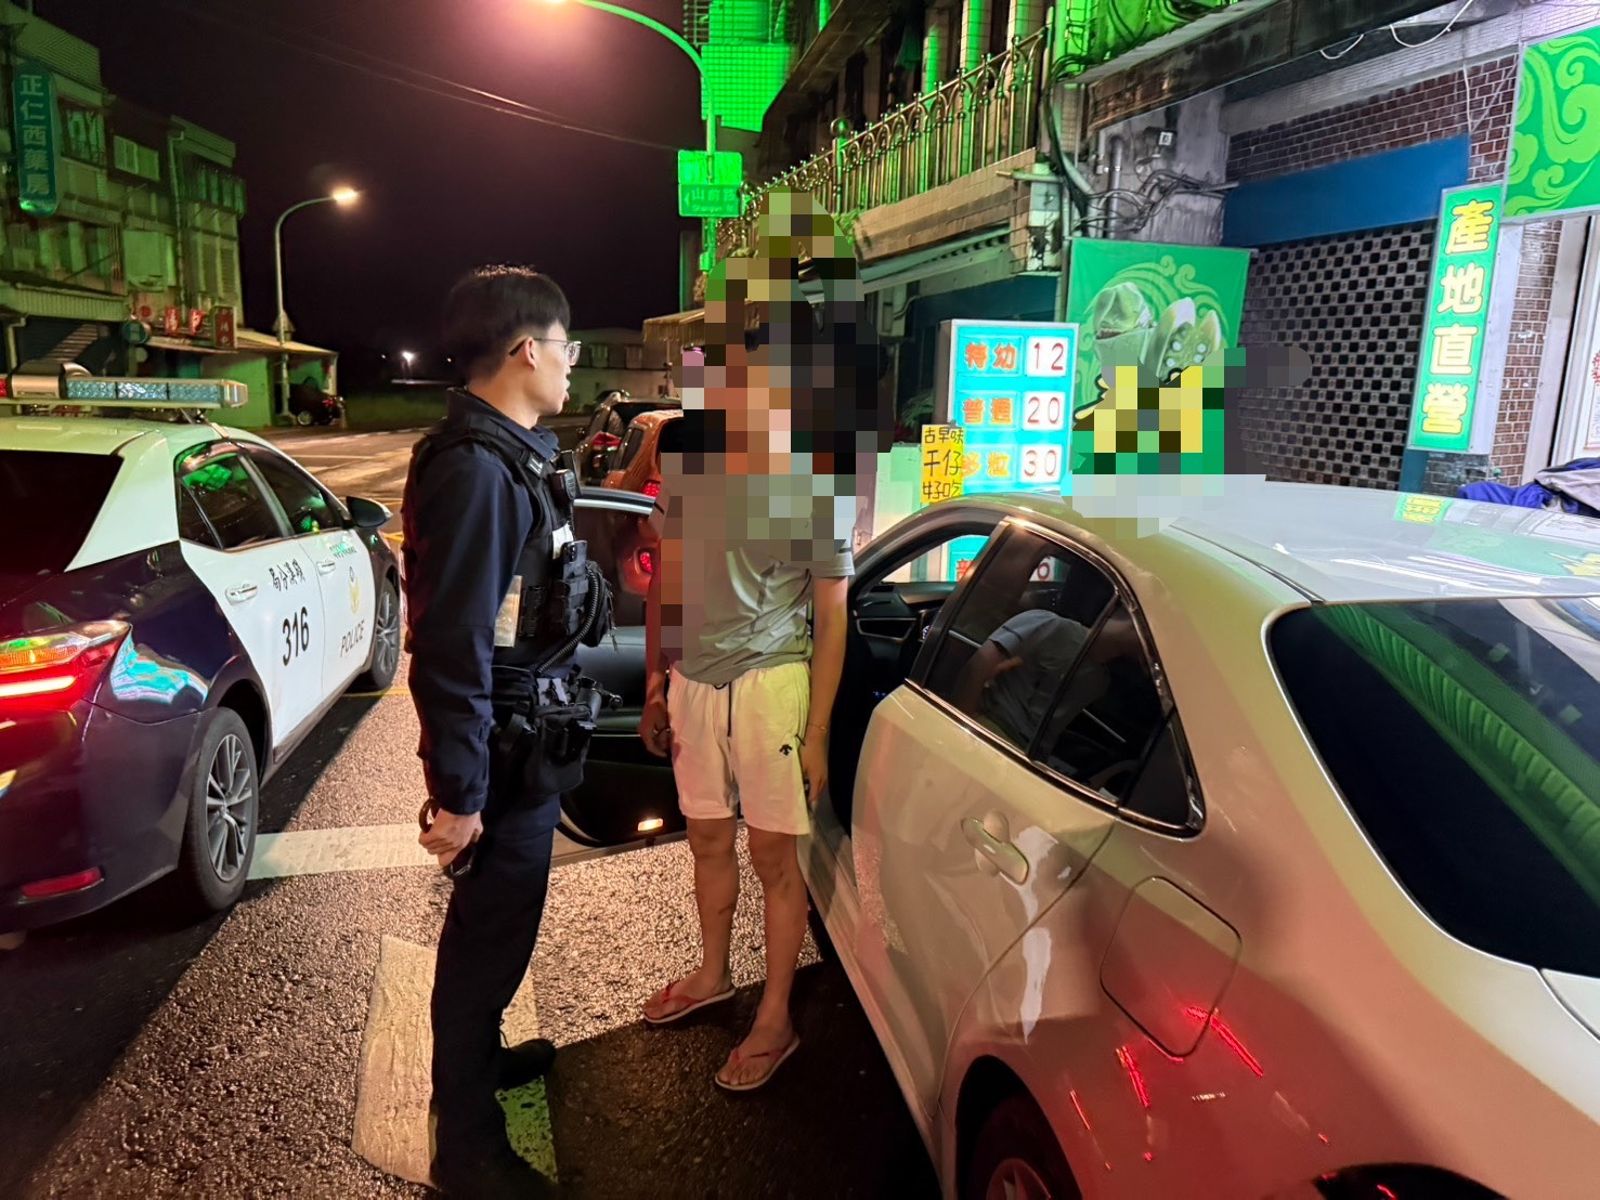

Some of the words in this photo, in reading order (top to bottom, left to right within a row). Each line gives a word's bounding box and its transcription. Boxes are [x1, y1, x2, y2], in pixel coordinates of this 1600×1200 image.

[20, 74, 49, 195] 正仁西藥房
[1421, 199, 1494, 435] 產地直營
[964, 341, 1017, 370] 特幼
[1034, 342, 1064, 371] 12
[963, 397, 1013, 425] 普通
[1027, 396, 1060, 425] 20
[924, 427, 964, 444] 古早味
[1024, 449, 1057, 477] 30
[922, 480, 962, 499] 好吃
[282, 605, 310, 666] 316
[340, 618, 365, 659] POLICE
